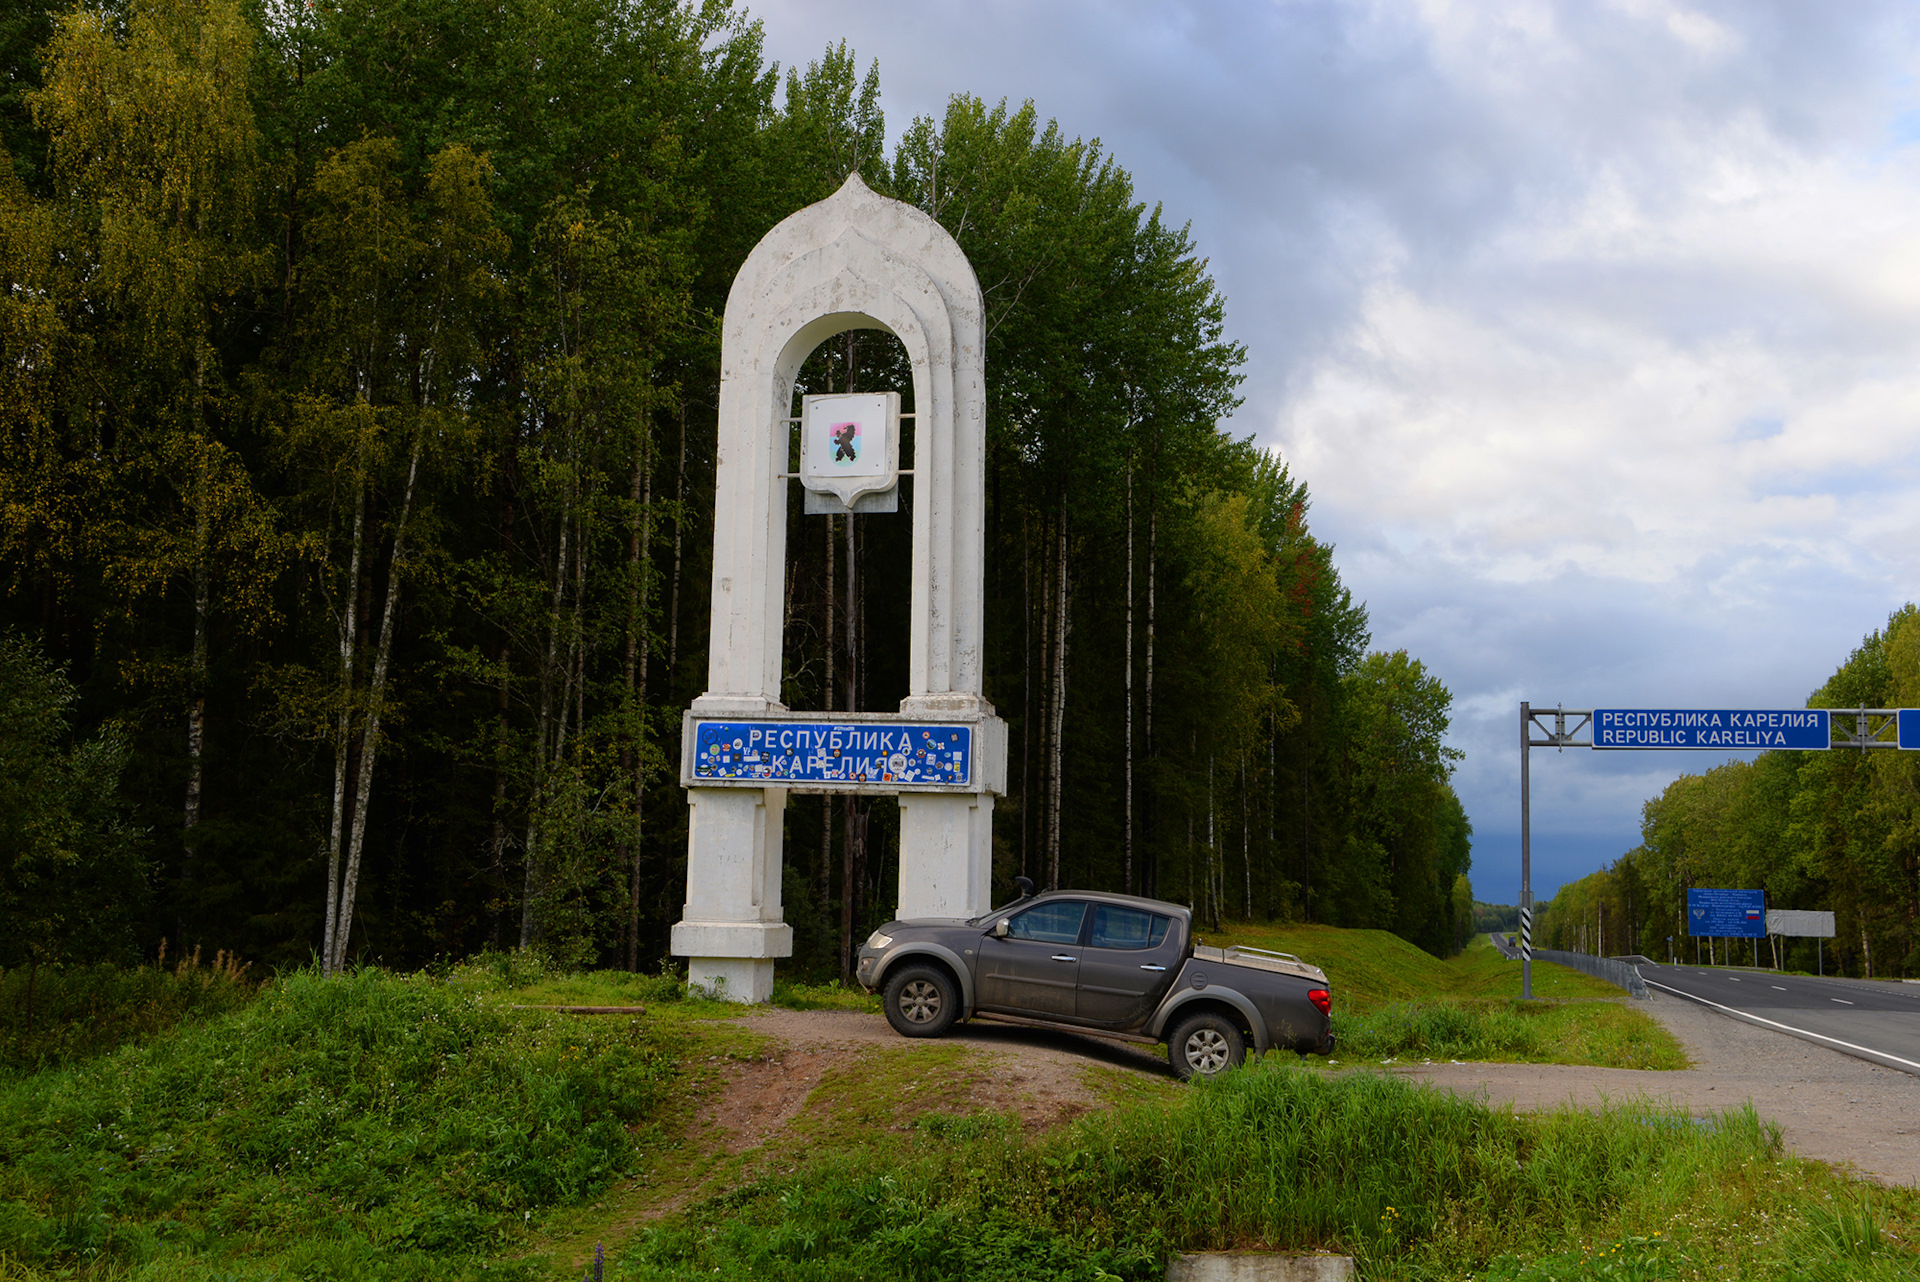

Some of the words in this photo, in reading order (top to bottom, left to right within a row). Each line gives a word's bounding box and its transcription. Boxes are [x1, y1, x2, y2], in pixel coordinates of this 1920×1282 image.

[1602, 712, 1722, 728] РЕСПУБЛИКА
[1730, 713, 1819, 728] КАРЕЛИЯ
[749, 730, 913, 751] РЕСПУБЛИКА
[1602, 729, 1687, 744] REPUBLIC
[1696, 730, 1787, 745] KARELIYA
[771, 755, 888, 775] КАРЕЛИЯ
